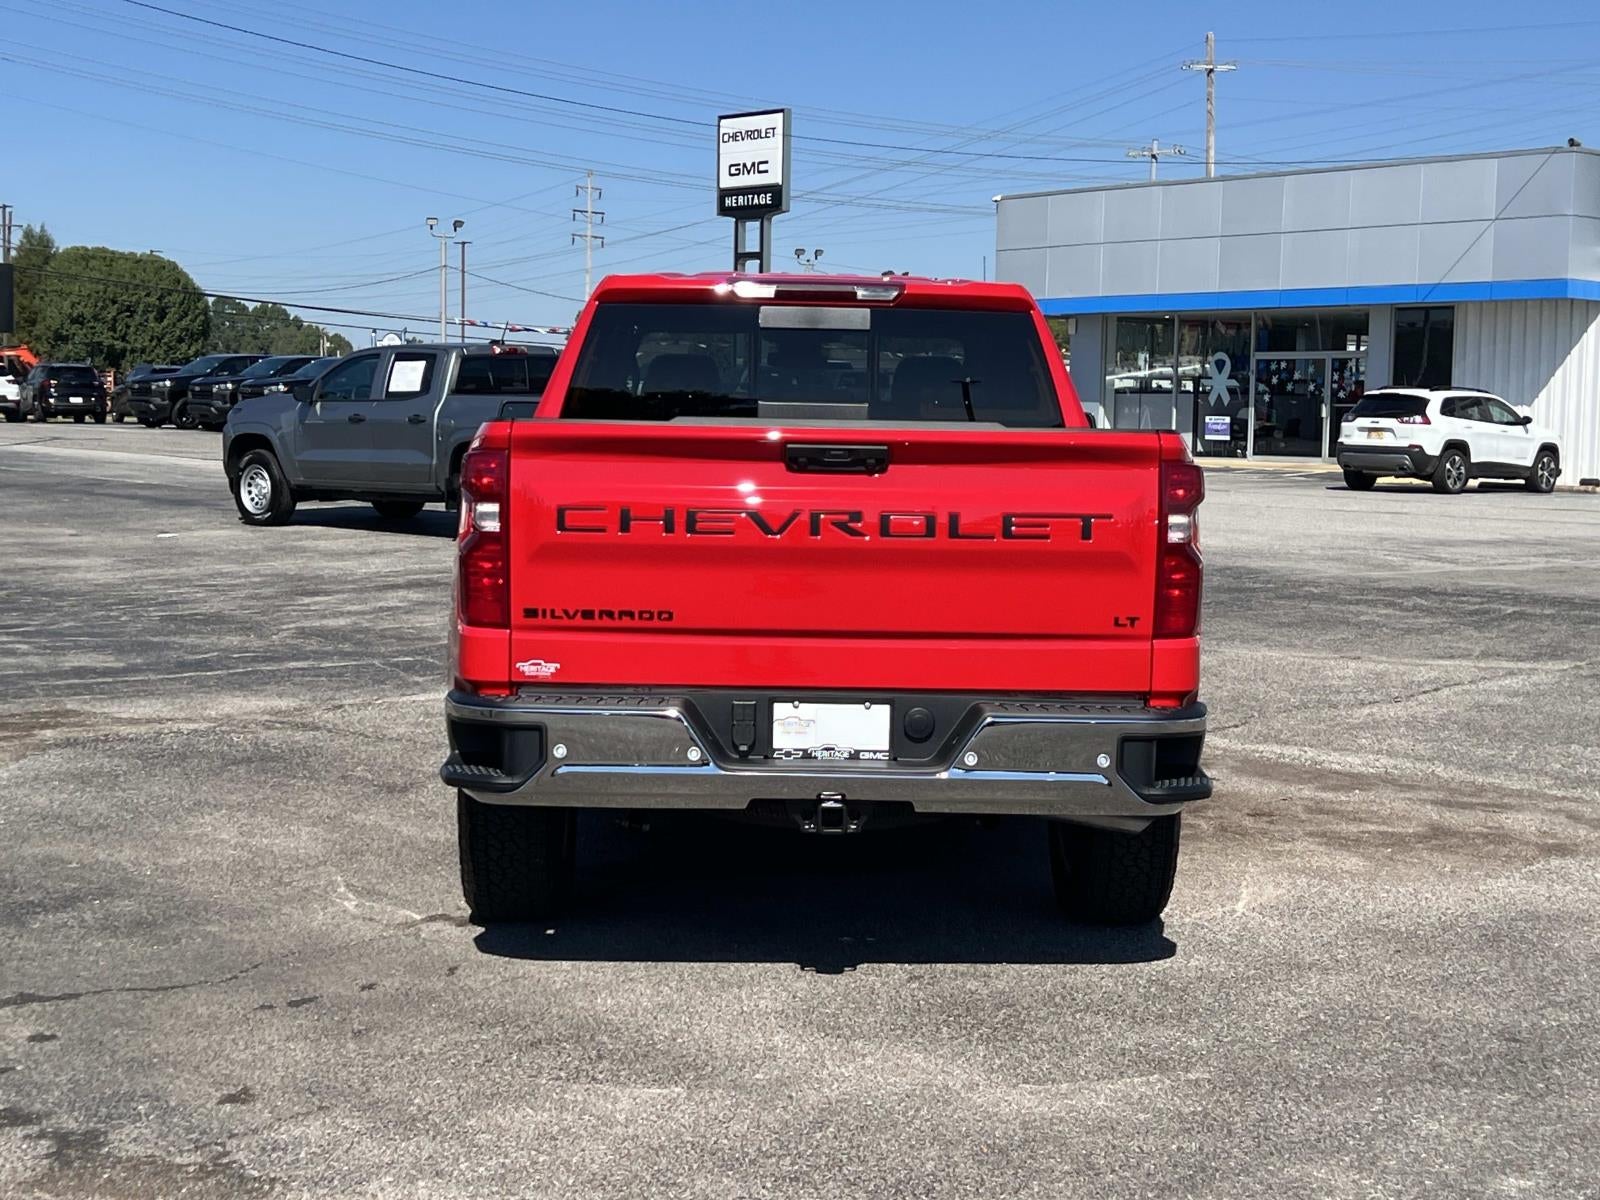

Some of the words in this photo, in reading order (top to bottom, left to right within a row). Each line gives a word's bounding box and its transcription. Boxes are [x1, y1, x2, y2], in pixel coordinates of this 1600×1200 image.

[721, 127, 776, 143] CHEVROLET
[728, 160, 769, 177] GMC
[725, 194, 772, 207] HERITAGE
[556, 505, 1113, 542] CHEVROLET
[523, 607, 674, 621] SILVERADO
[1113, 616, 1141, 628] LT
[811, 750, 850, 759] HERITAGE
[860, 752, 889, 760] GMC
